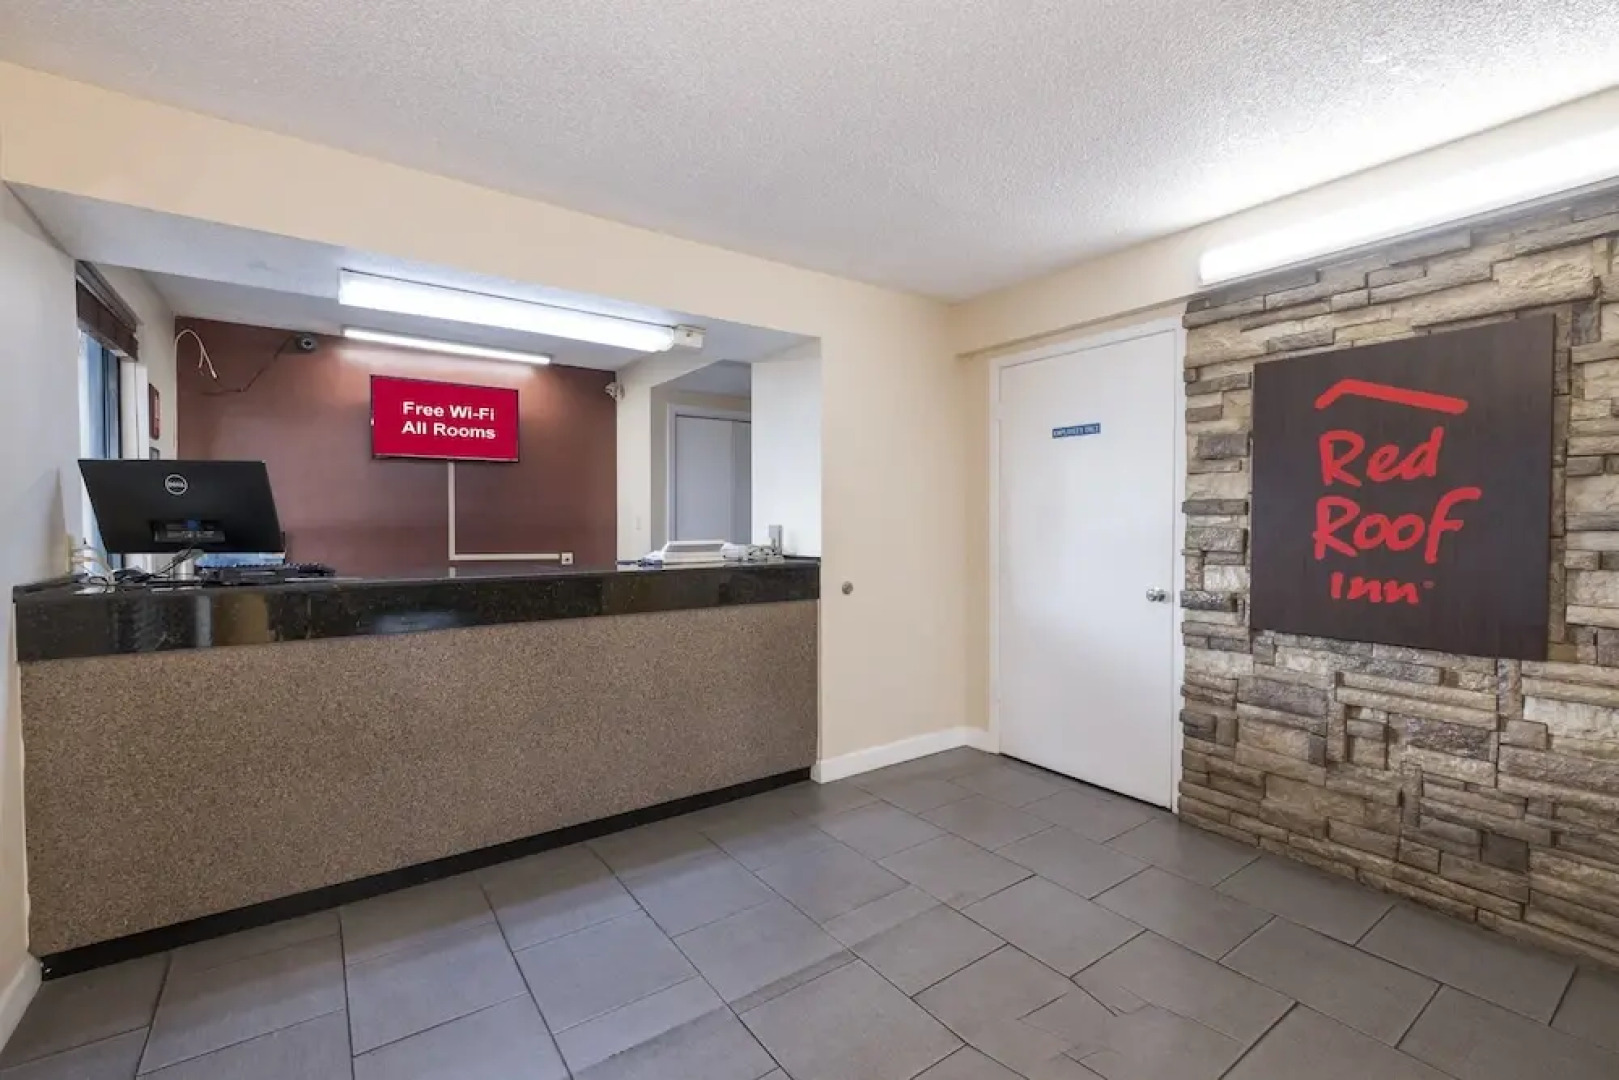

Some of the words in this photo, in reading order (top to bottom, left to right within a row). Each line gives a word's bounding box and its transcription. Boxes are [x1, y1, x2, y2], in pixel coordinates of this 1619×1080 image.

[403, 402, 444, 416] Free
[450, 405, 494, 420] Wi-Fi
[402, 421, 426, 434] All
[434, 423, 495, 439] Rooms
[1318, 427, 1444, 486] Red
[1313, 488, 1482, 564] Roof
[1331, 572, 1419, 604] Inn
